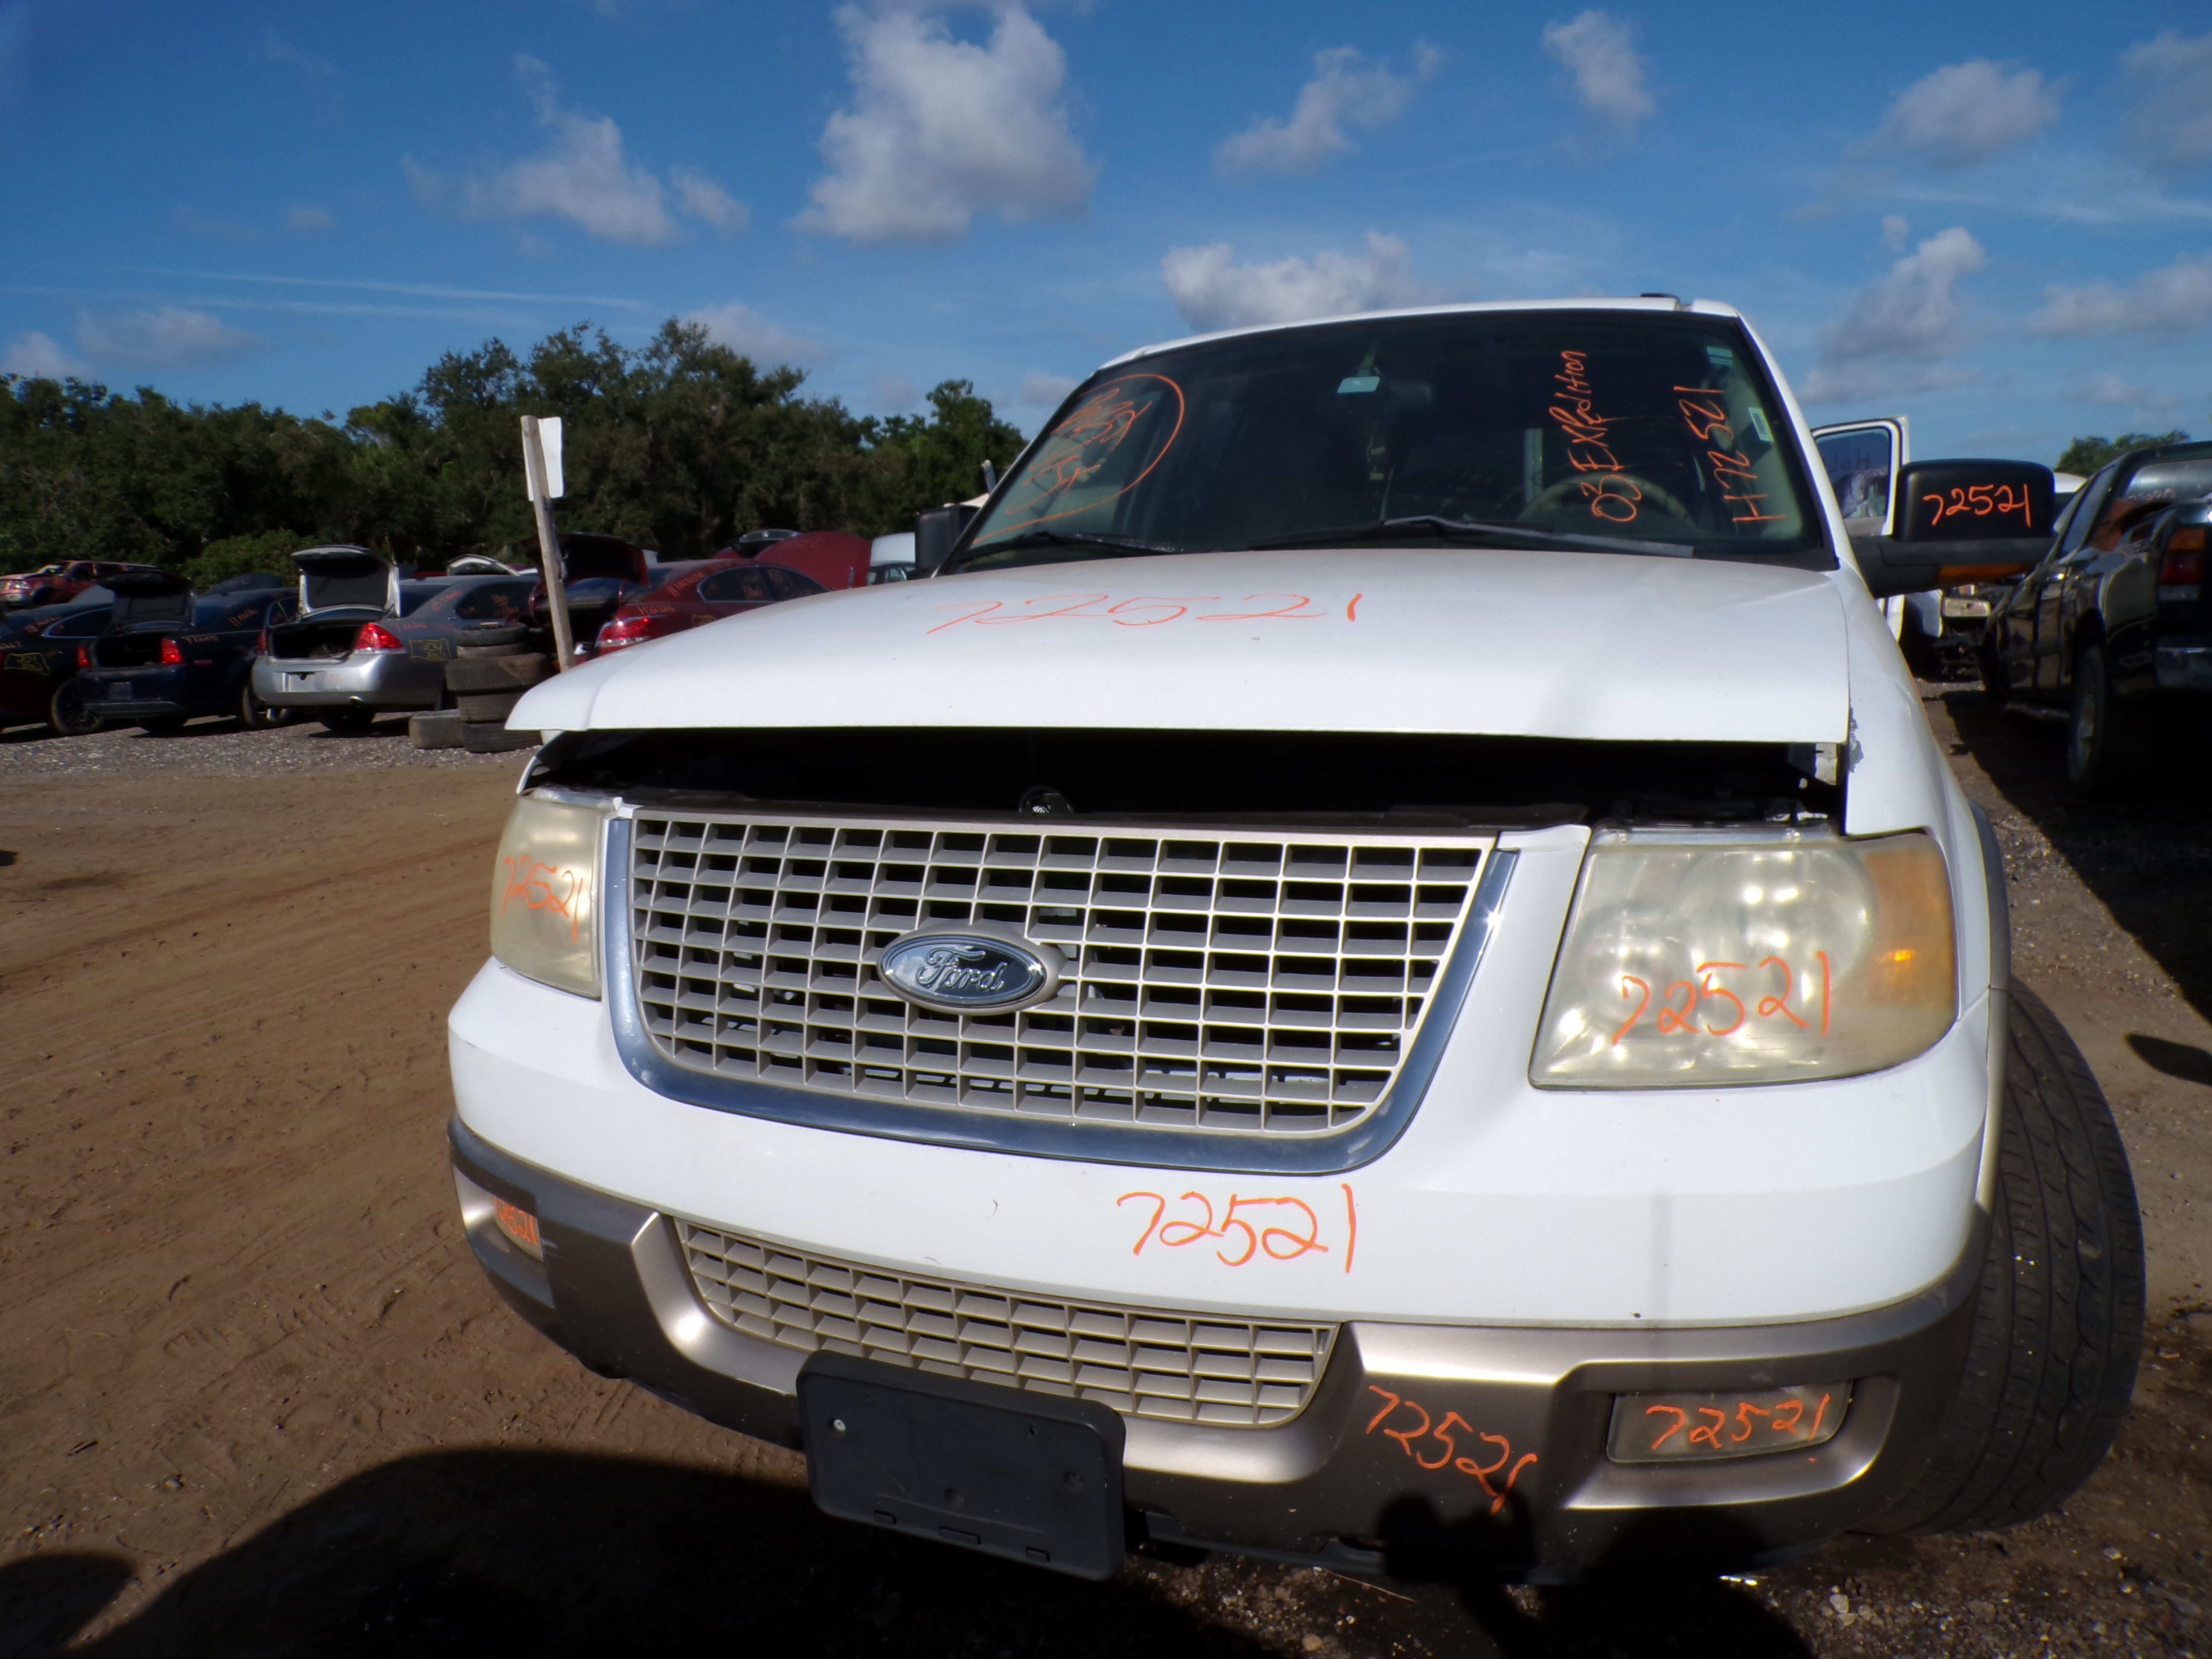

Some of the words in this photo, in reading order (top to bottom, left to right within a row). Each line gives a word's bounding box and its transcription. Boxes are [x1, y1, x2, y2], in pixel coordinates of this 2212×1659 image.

[1581, 474, 1642, 522] 03
[1923, 483, 2032, 527] 72521
[927, 592, 1363, 634] 72521
[501, 854, 583, 943] 72521
[917, 946, 1008, 991] Ford
[1612, 951, 1831, 1045] 72521
[1116, 1183, 1357, 1273] 72521
[1645, 1393, 1831, 1450] 72521
